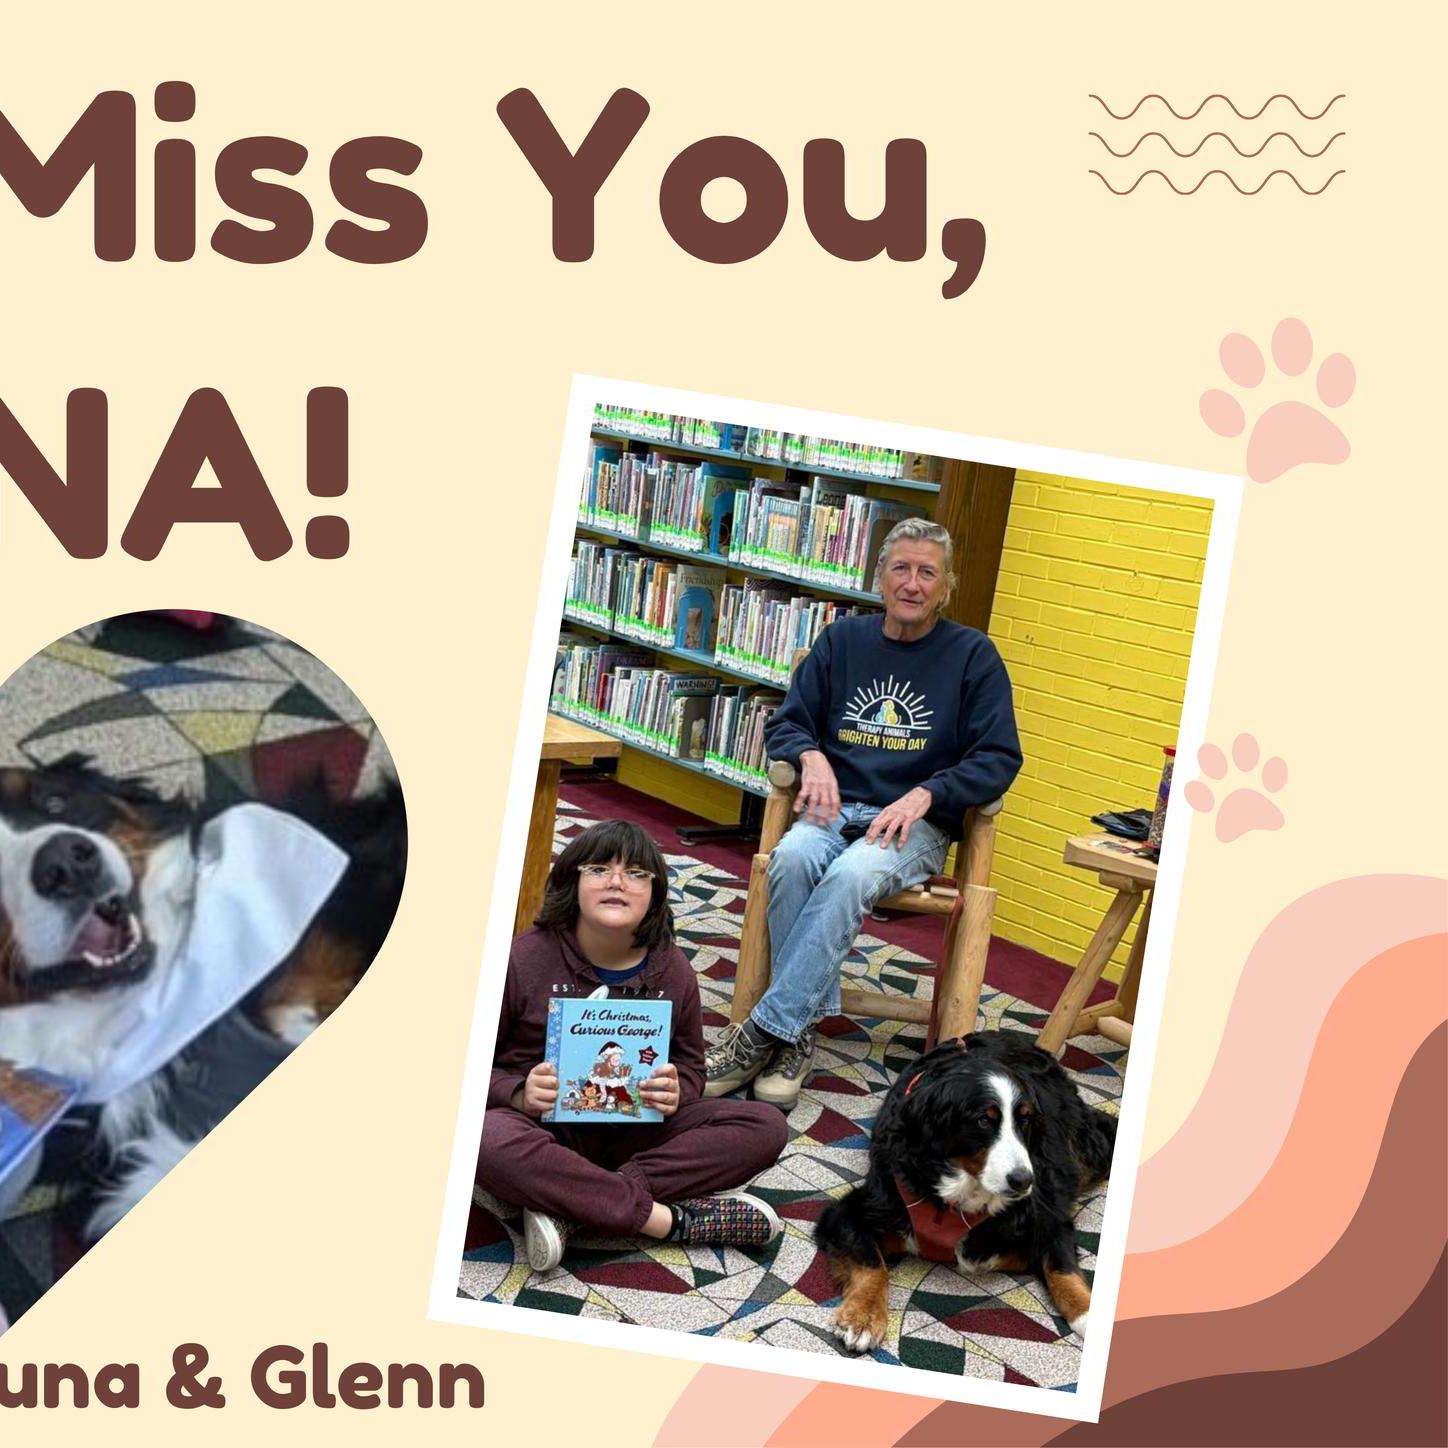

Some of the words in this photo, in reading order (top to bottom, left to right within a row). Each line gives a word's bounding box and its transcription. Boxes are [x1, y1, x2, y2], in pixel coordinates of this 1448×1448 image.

[856, 722, 883, 735] THERAPY
[883, 726, 911, 738] ANIMALS
[838, 728, 881, 748] BRIGHTEN
[881, 736, 907, 750] YOUR
[907, 738, 928, 751] DAY
[581, 1008, 597, 1021] It's
[598, 1009, 653, 1023] Christmas,
[570, 1023, 616, 1036] Curious
[617, 1024, 664, 1039] George!
